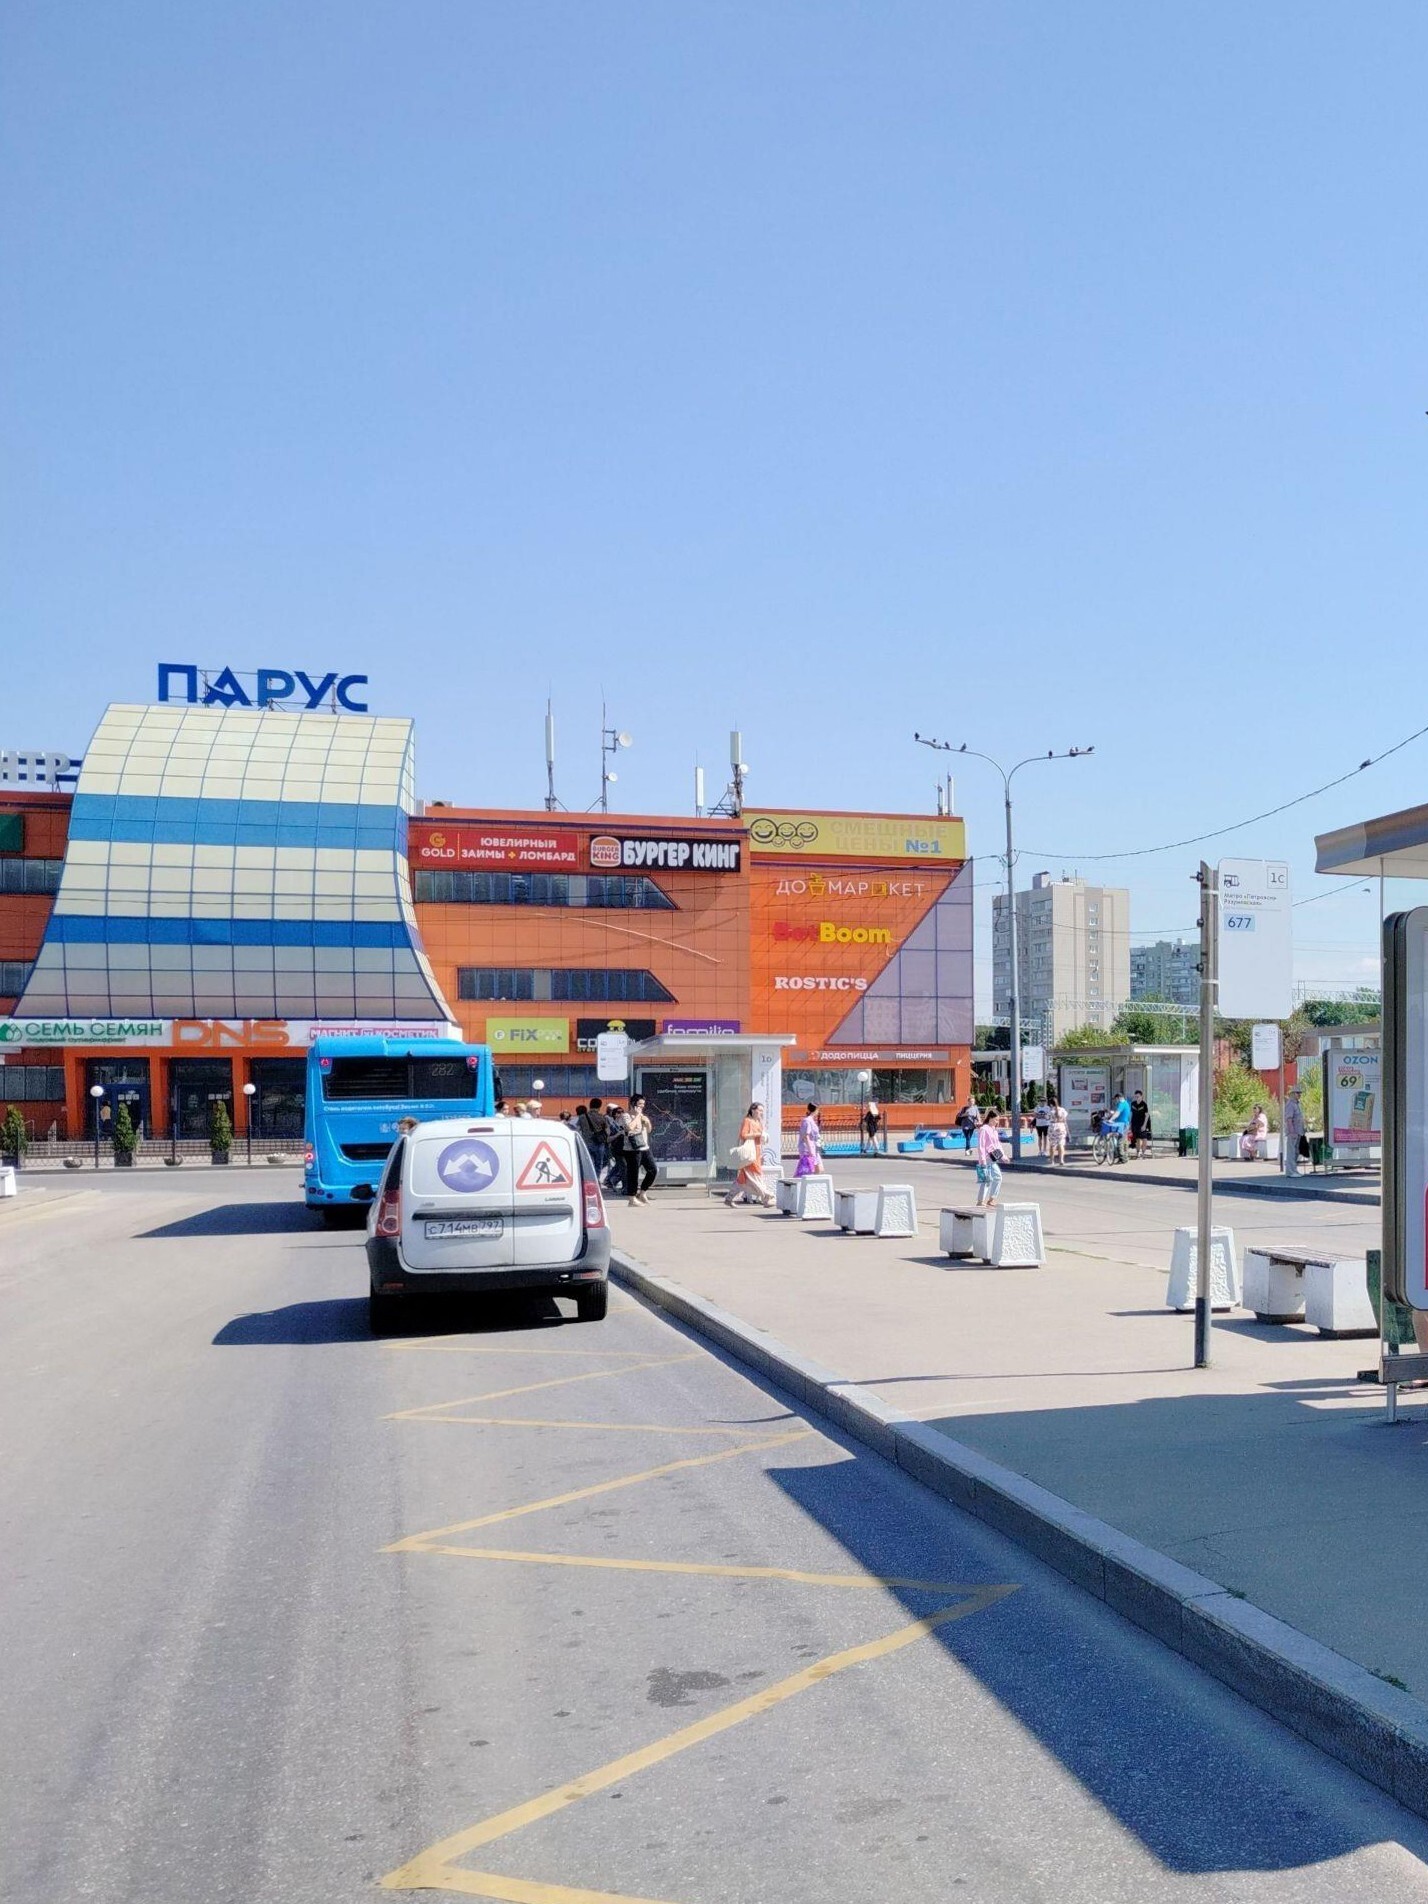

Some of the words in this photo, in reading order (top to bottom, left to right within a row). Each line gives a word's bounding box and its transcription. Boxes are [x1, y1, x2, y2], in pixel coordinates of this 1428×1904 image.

[158, 663, 368, 712] ПАРУС
[830, 821, 948, 838] СМЕШНЫЕ
[480, 837, 557, 849] ЮВЕЛИРНЫЙ
[835, 836, 900, 852] ЦЕНЫ
[905, 839, 942, 854] №1
[421, 848, 455, 858] GOLD
[519, 851, 576, 862] ЛОМБАРД
[592, 851, 619, 860] KING
[623, 840, 690, 867] БУРГЕР
[692, 843, 740, 869] КИНГ
[1228, 917, 1251, 929] 677
[772, 921, 891, 943] BetBoom
[775, 976, 868, 990] ROSTIC'S
[25, 1022, 85, 1036] СЕМЬ
[90, 1022, 162, 1036] СЕМЯН
[171, 1020, 290, 1047] DNS
[1343, 1055, 1378, 1065] OZON
[432, 1063, 455, 1077] 282
[481, 1220, 499, 1229] 797
